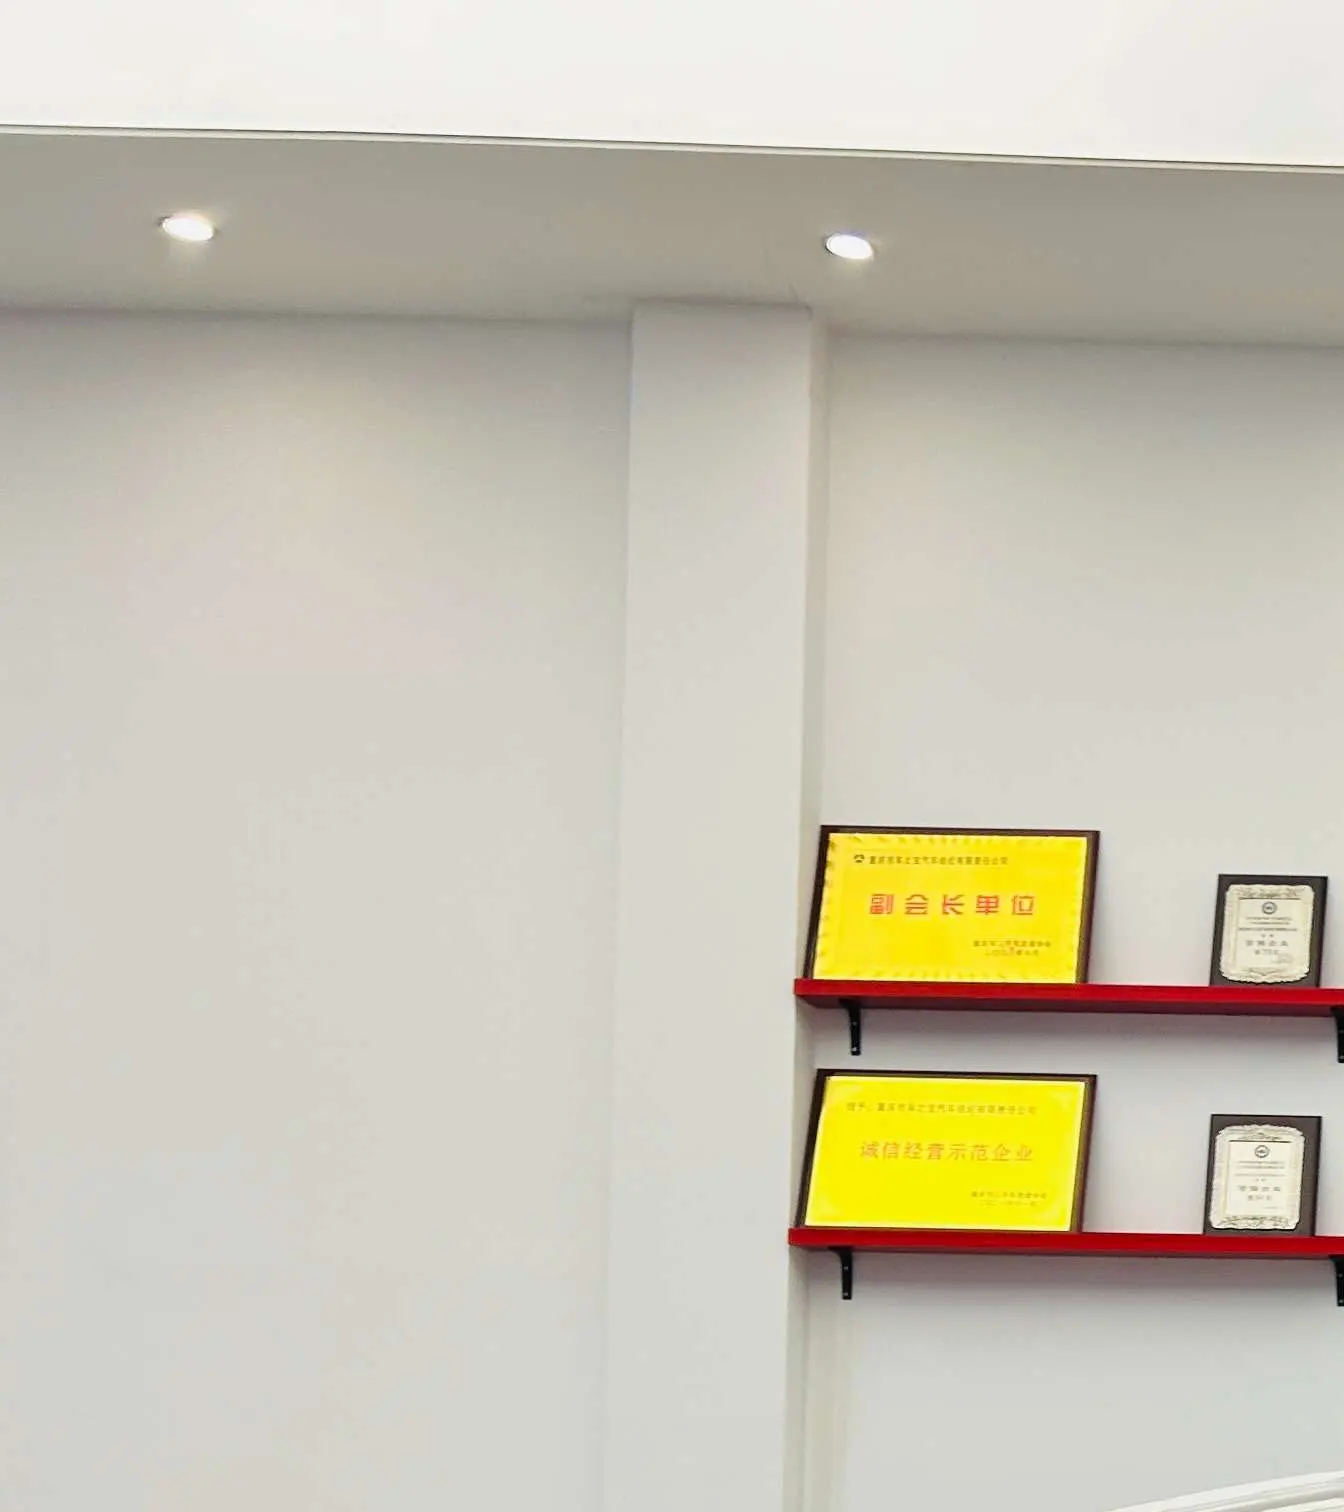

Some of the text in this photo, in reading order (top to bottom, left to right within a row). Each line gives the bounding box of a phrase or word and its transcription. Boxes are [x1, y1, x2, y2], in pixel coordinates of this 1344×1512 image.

[868, 893, 1035, 916] 副会长单位
[860, 1141, 1034, 1162] 诚信经营示范企业
